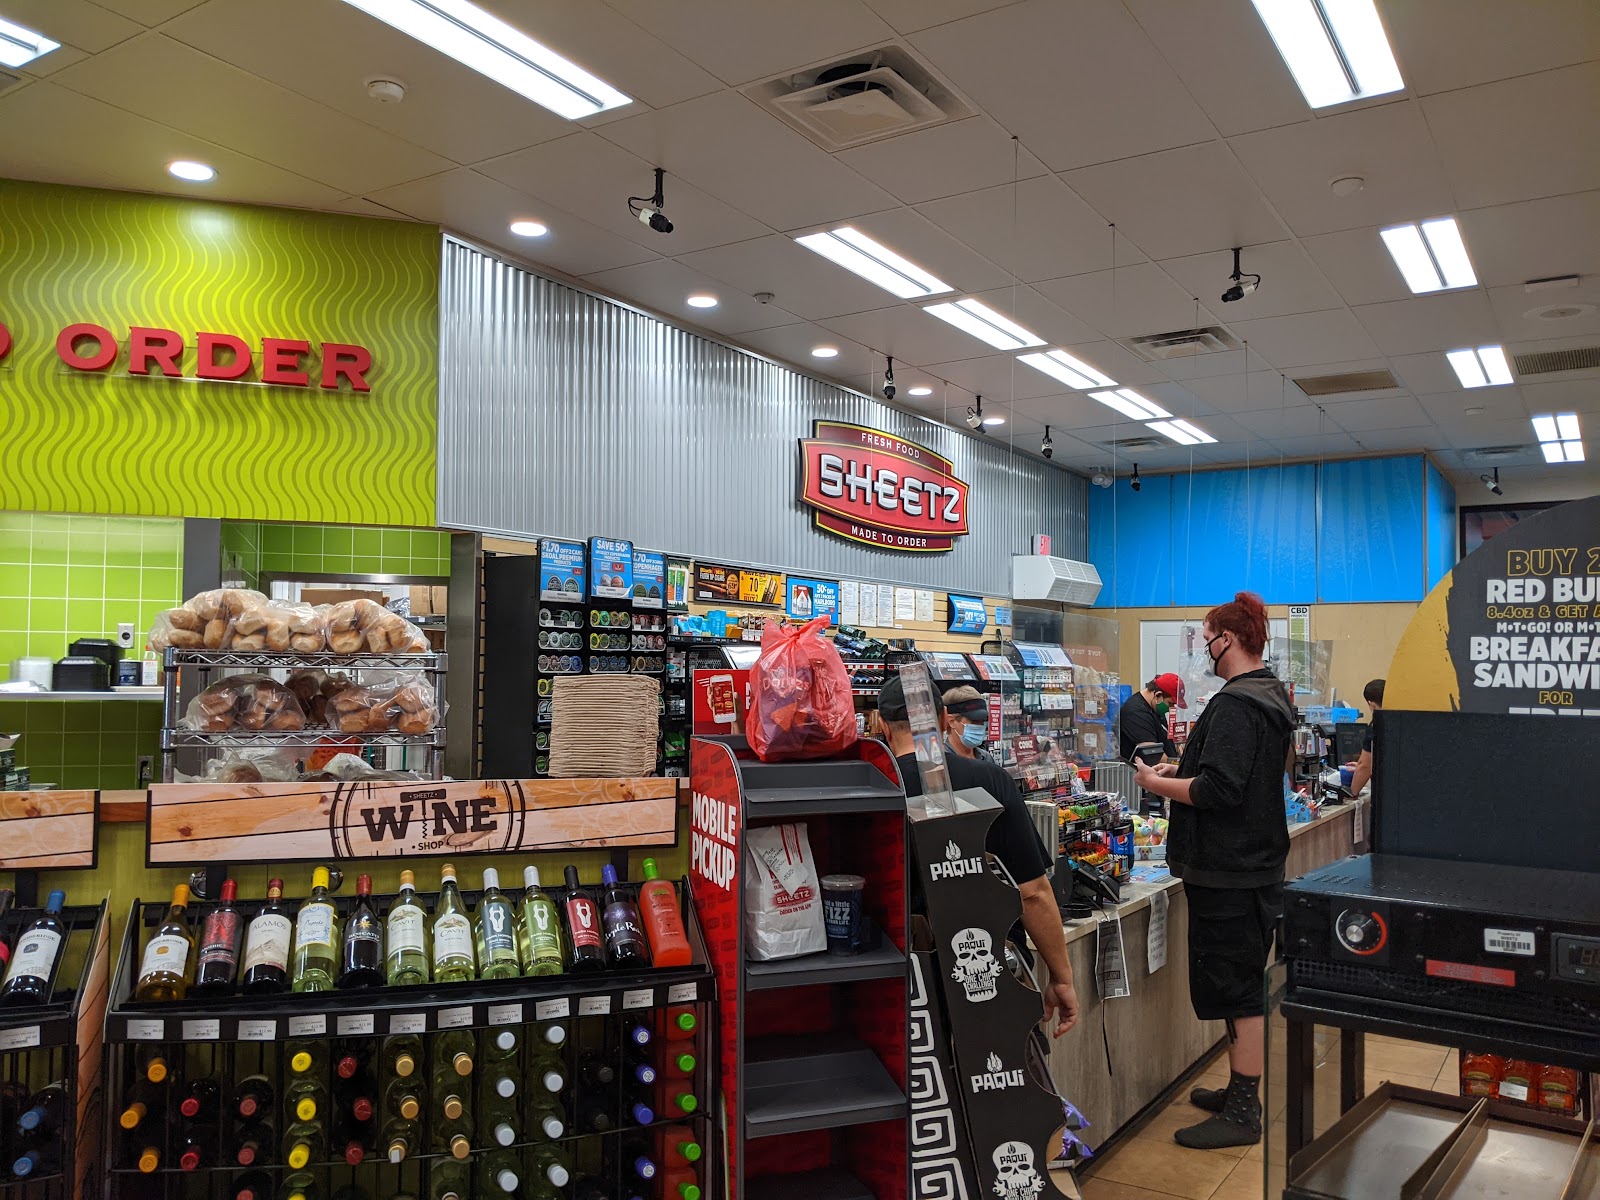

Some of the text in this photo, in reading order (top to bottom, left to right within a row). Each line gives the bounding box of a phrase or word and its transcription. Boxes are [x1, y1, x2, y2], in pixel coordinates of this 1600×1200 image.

[56, 322, 372, 392] ORDER
[862, 433, 920, 458] FRESH FOOD
[820, 454, 960, 522] SHEETZ
[851, 525, 927, 547] MADE TO ORDER
[542, 541, 560, 552] $1.70
[596, 540, 628, 552] SAVE 50¢
[559, 554, 582, 562] PREMIUM
[1508, 548, 1577, 576] BUY
[817, 584, 827, 593] 50¢
[1487, 579, 1546, 604] RED
[1487, 606, 1533, 618] 8.4oz
[1538, 606, 1550, 618] &
[1556, 605, 1589, 618] GET
[1554, 622, 1574, 633] OR
[1539, 691, 1573, 705] FOR
[360, 797, 497, 842] WINE
[693, 791, 736, 845] MOBILE
[418, 841, 444, 851] SHOP
[692, 831, 735, 891] PICKUP
[825, 907, 850, 920] FIZZ
[253, 920, 286, 930] ALAMOS
[391, 920, 415, 931] CAVIT
[440, 928, 465, 937] CAVIT
[964, 972, 992, 984] ONE CHIP
[967, 980, 993, 990] CHALLENGE
[1006, 1187, 1034, 1198] ONE CHIP
